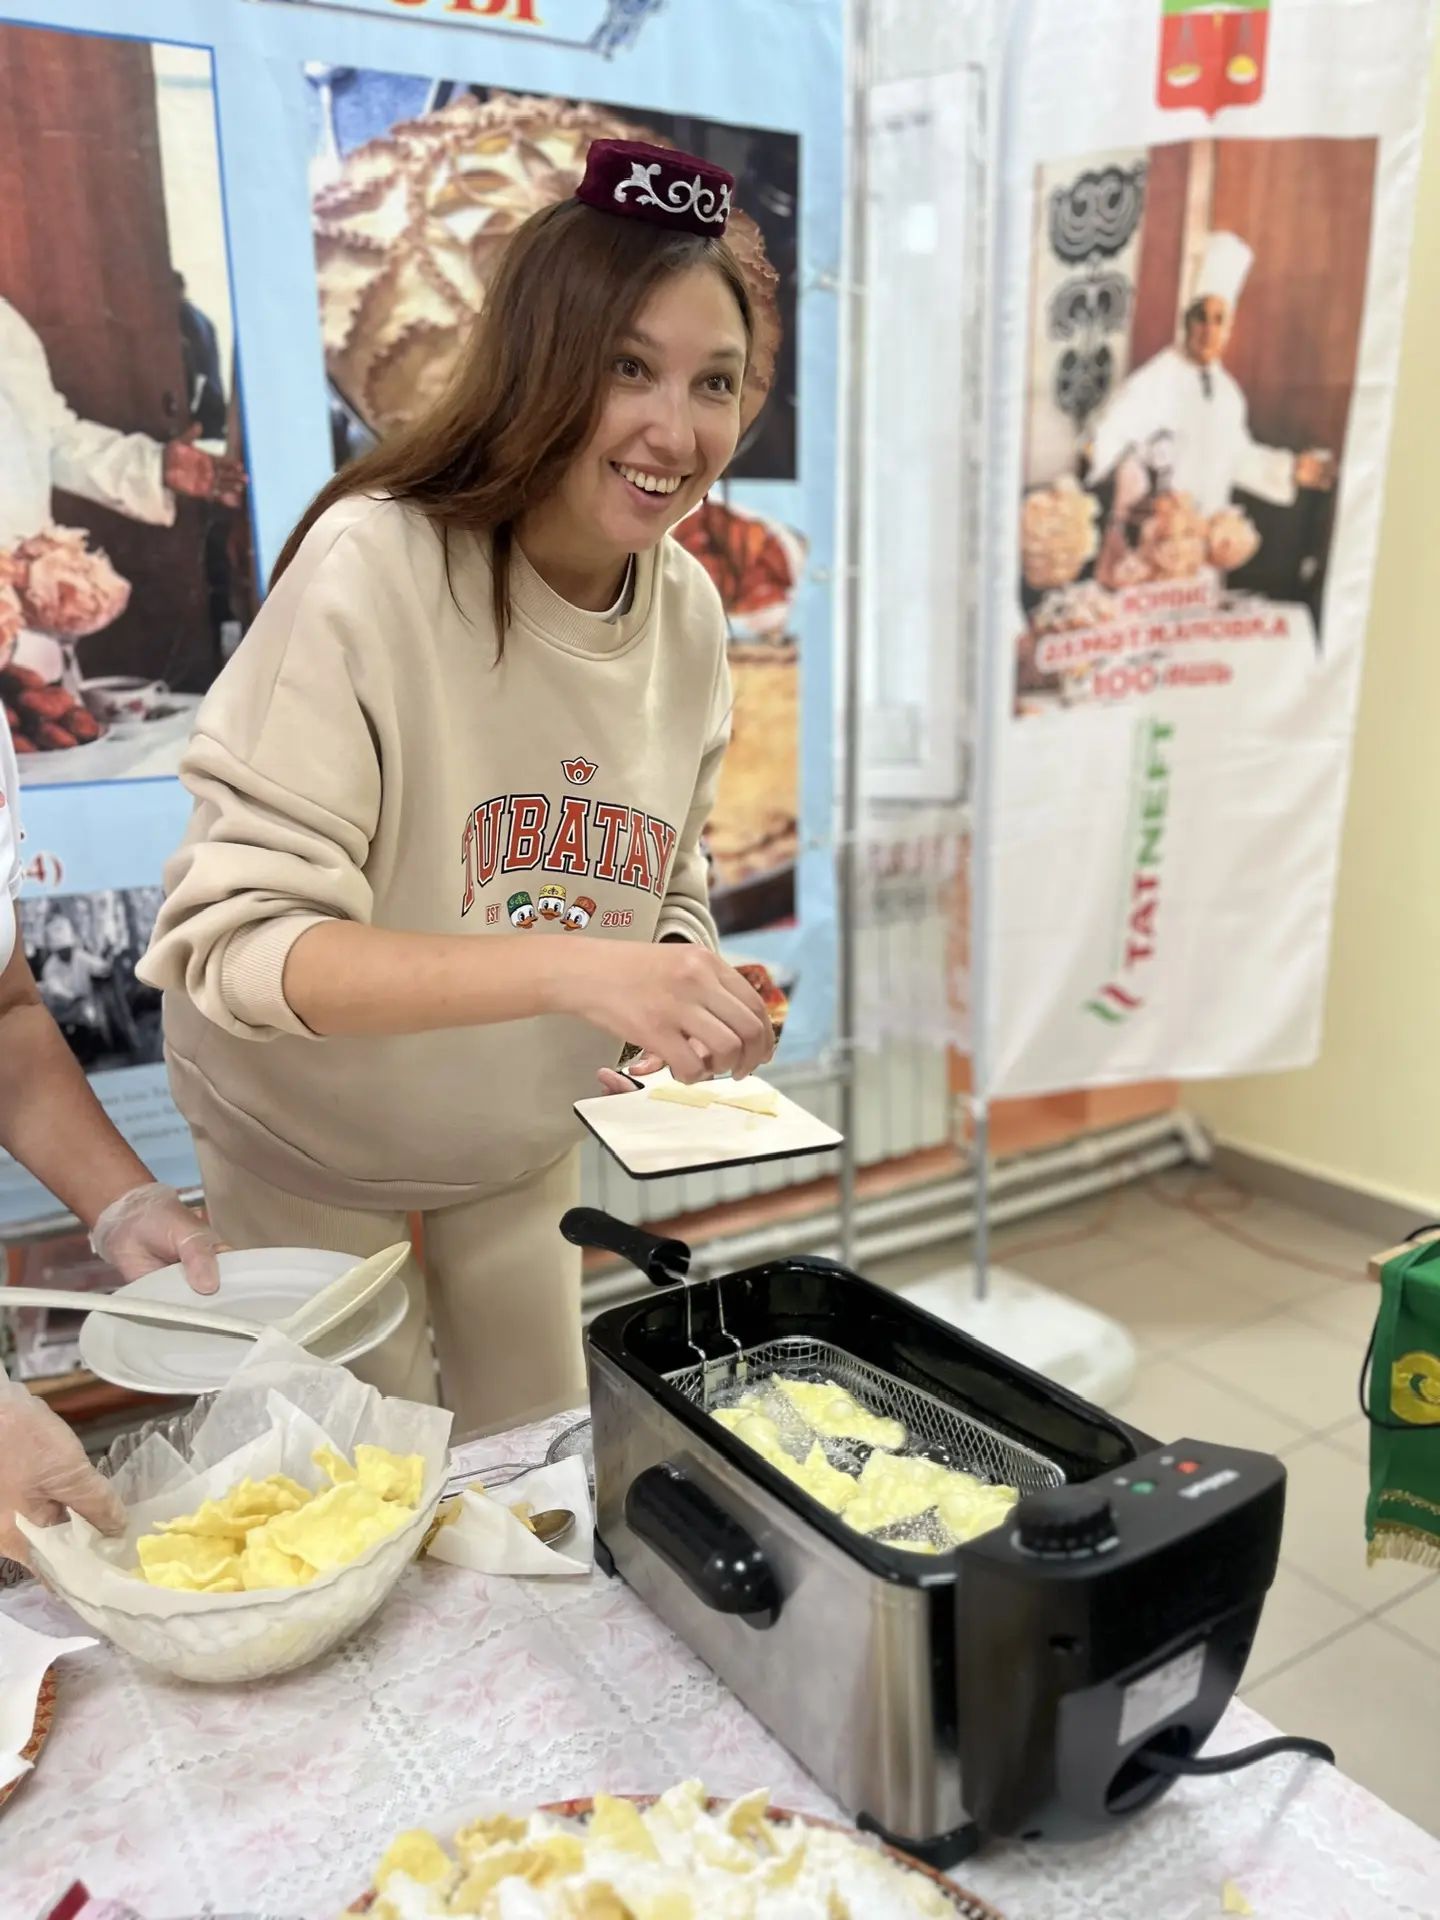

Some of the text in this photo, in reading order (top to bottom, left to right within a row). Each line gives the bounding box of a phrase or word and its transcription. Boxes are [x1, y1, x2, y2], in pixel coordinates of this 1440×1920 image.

[1124, 720, 1174, 968] TATNEFT
[486, 904, 500, 925] EST
[601, 909, 634, 928] 2015
